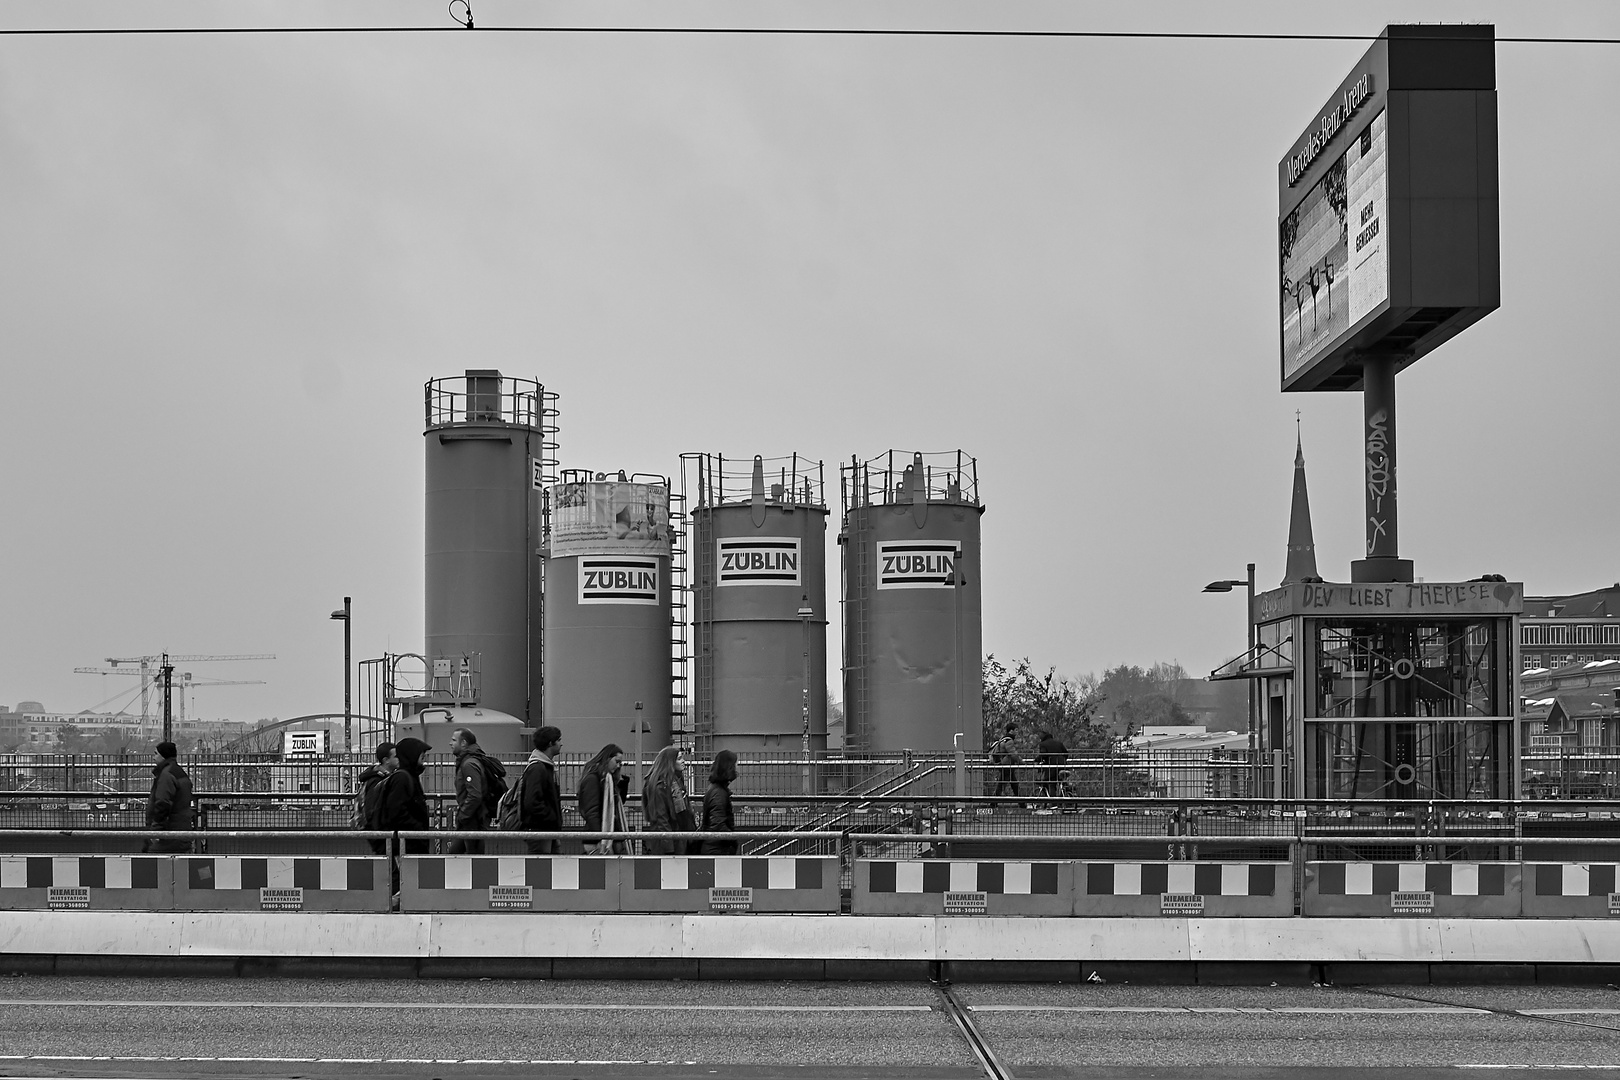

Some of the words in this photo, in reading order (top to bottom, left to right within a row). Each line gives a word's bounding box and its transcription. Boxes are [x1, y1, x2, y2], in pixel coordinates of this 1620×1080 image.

[1287, 105, 1341, 188] Mercedes-Benz
[1342, 73, 1368, 123] Arena
[1360, 200, 1374, 228] MEHR
[1355, 216, 1380, 253] GENIESSEN
[721, 552, 797, 571] ZÜBLIN
[882, 555, 955, 574] ZÜBLIN
[583, 571, 656, 590] ZÜBLIN
[1349, 586, 1393, 609] LIEBT
[712, 889, 750, 897] NIEMEIER
[946, 893, 985, 901] NIEMEIER
[1394, 893, 1431, 901] NIEMEIER
